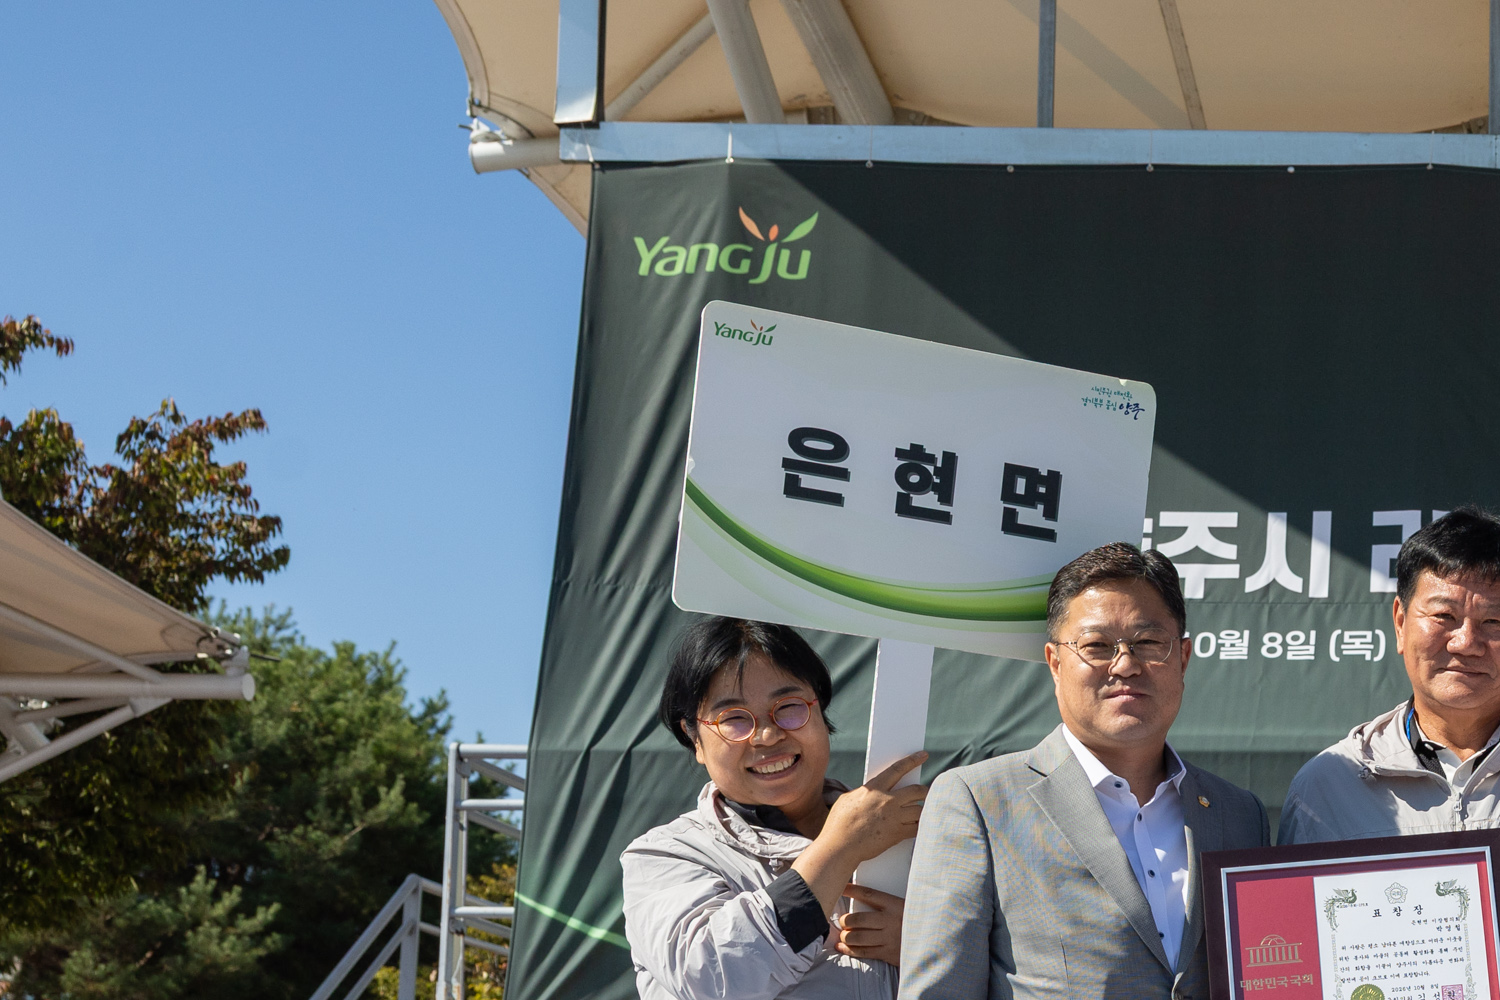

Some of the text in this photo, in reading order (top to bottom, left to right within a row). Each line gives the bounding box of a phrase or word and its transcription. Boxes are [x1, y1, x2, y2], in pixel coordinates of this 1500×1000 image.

[1119, 402, 1146, 420] 양주
[1143, 510, 1334, 600] 주시
[1259, 629, 1316, 662] 8일
[1328, 628, 1387, 662] (목)
